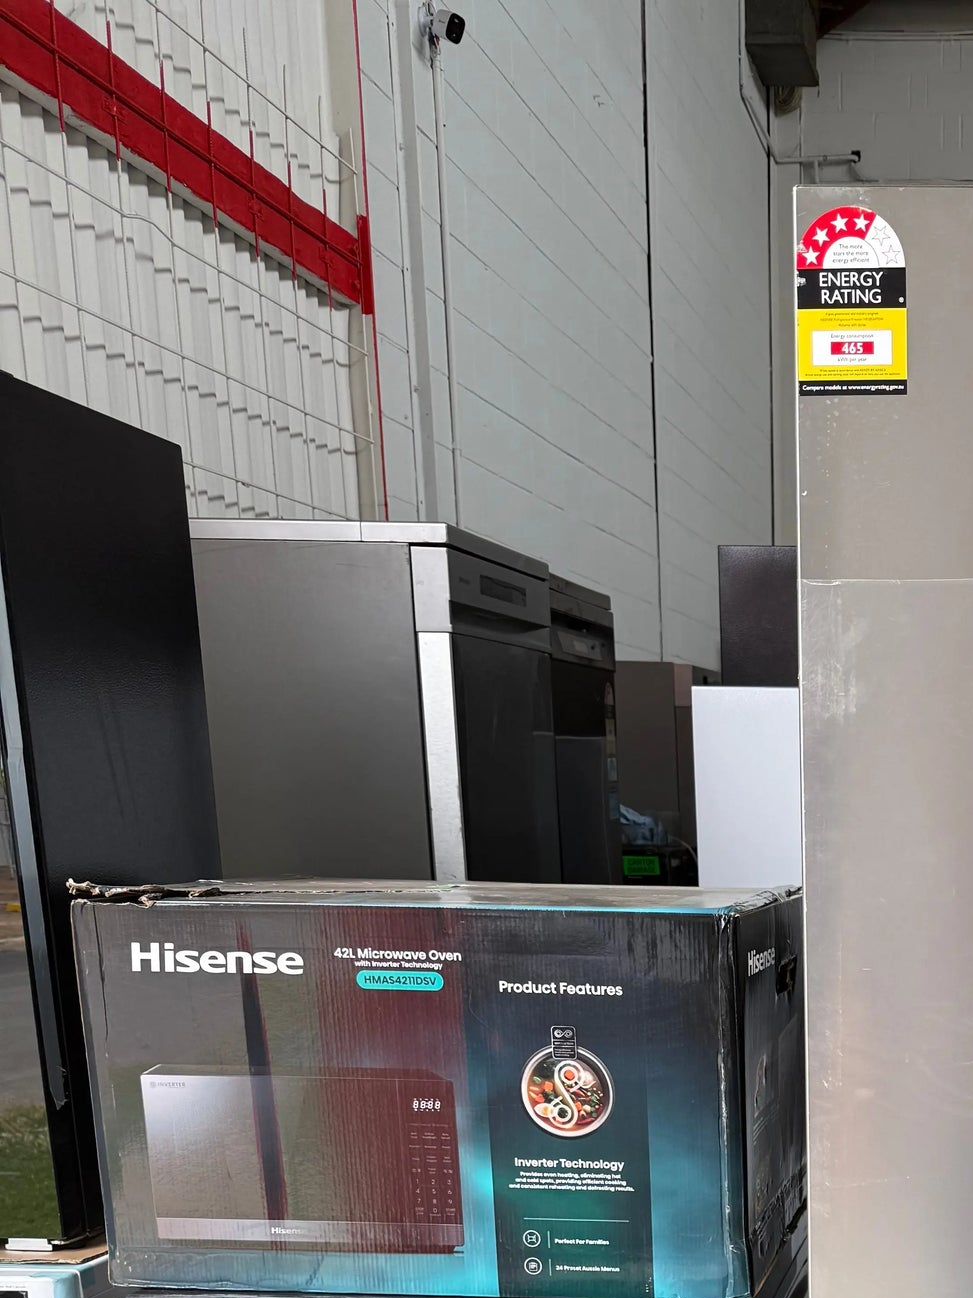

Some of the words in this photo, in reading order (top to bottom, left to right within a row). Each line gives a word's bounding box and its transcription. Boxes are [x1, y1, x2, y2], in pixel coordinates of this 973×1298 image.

[819, 272, 883, 287] ENERGY
[821, 289, 882, 304] RATING
[842, 342, 864, 354] 465
[131, 942, 304, 974] Hisense
[334, 948, 356, 958] 42L
[358, 948, 427, 960] Microwave
[428, 950, 462, 961] Oven
[401, 961, 443, 970] Technology
[748, 947, 776, 977] Hisense
[364, 976, 437, 986] HMAS4211DSV
[498, 980, 558, 994] Product
[559, 982, 624, 996] Features
[514, 1157, 558, 1168] Inverter
[560, 1158, 625, 1171] Technology
